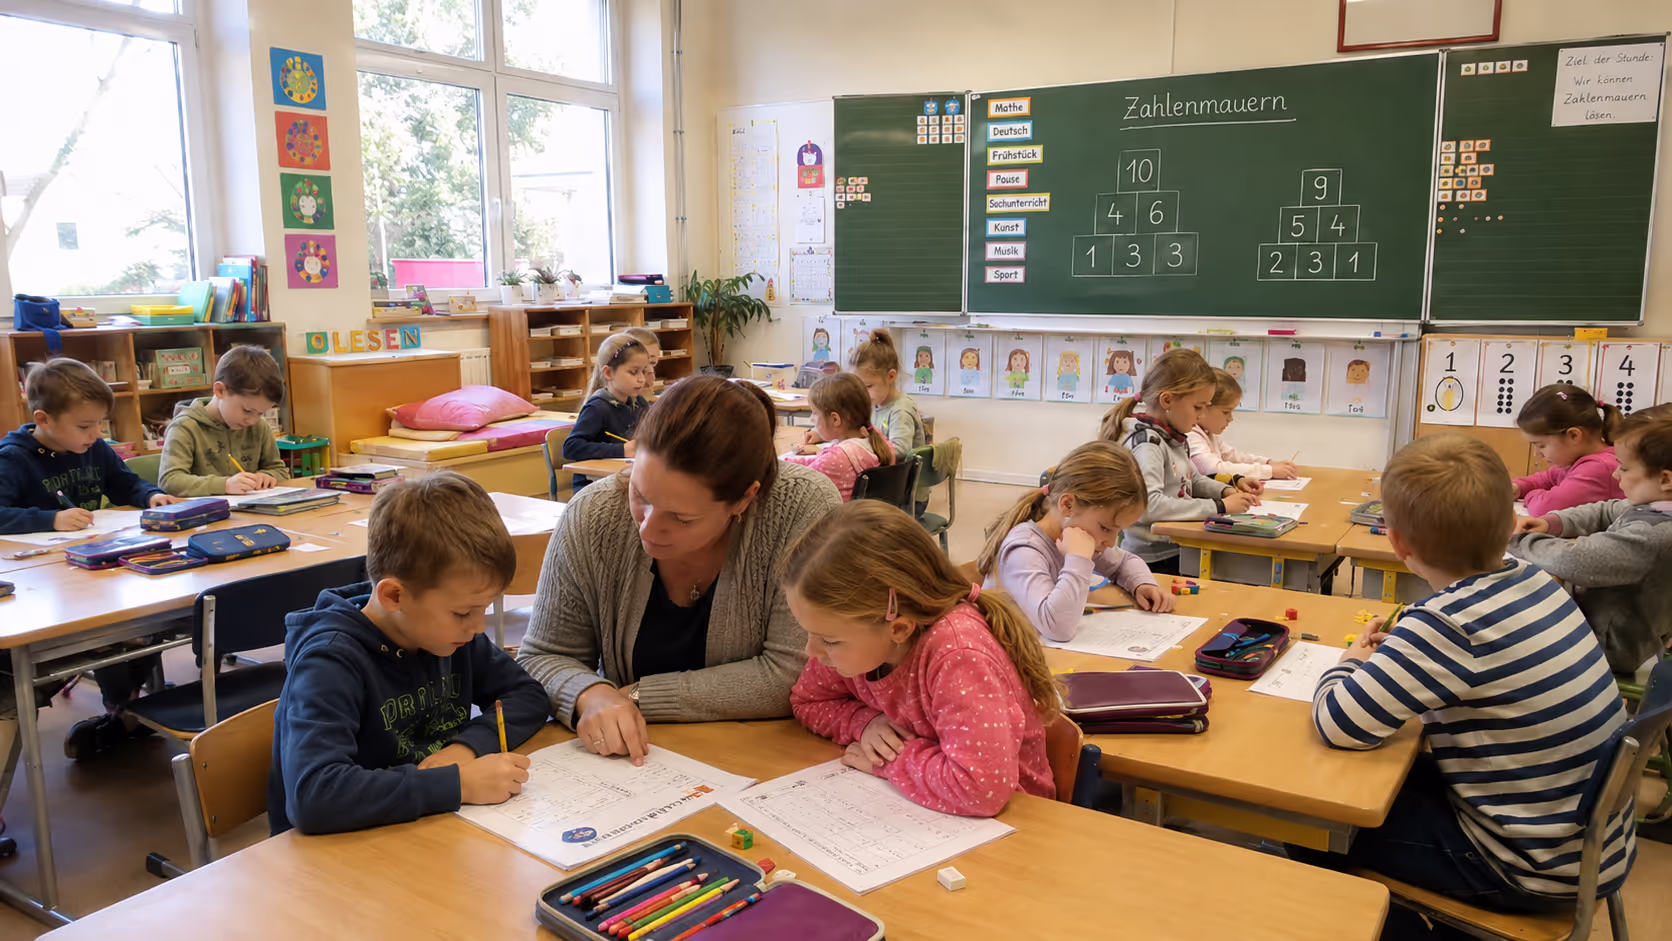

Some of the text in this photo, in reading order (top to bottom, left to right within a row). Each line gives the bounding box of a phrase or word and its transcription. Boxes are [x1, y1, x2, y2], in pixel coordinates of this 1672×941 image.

[1565, 52, 1654, 67] Ziel der Stunde:
[1573, 75, 1633, 86] Wir können
[1124, 92, 1288, 119] Zahlenmauern
[992, 125, 1028, 137] Deutsch
[992, 147, 1037, 160] Frühstück
[1127, 158, 1153, 183] 10
[1314, 175, 1328, 201] 9
[1107, 200, 1164, 226] 4 6
[994, 222, 1020, 233] Kunst
[1290, 214, 1346, 238] 5 4
[994, 245, 1019, 256] Musik
[1086, 243, 1183, 268] 1 3 3
[1269, 250, 1359, 274] 2 3 1
[994, 269, 1019, 281] Sport
[1444, 351, 1457, 372] 1
[1499, 352, 1515, 374] 2
[1558, 354, 1573, 375] 3
[1618, 354, 1636, 377] 4
